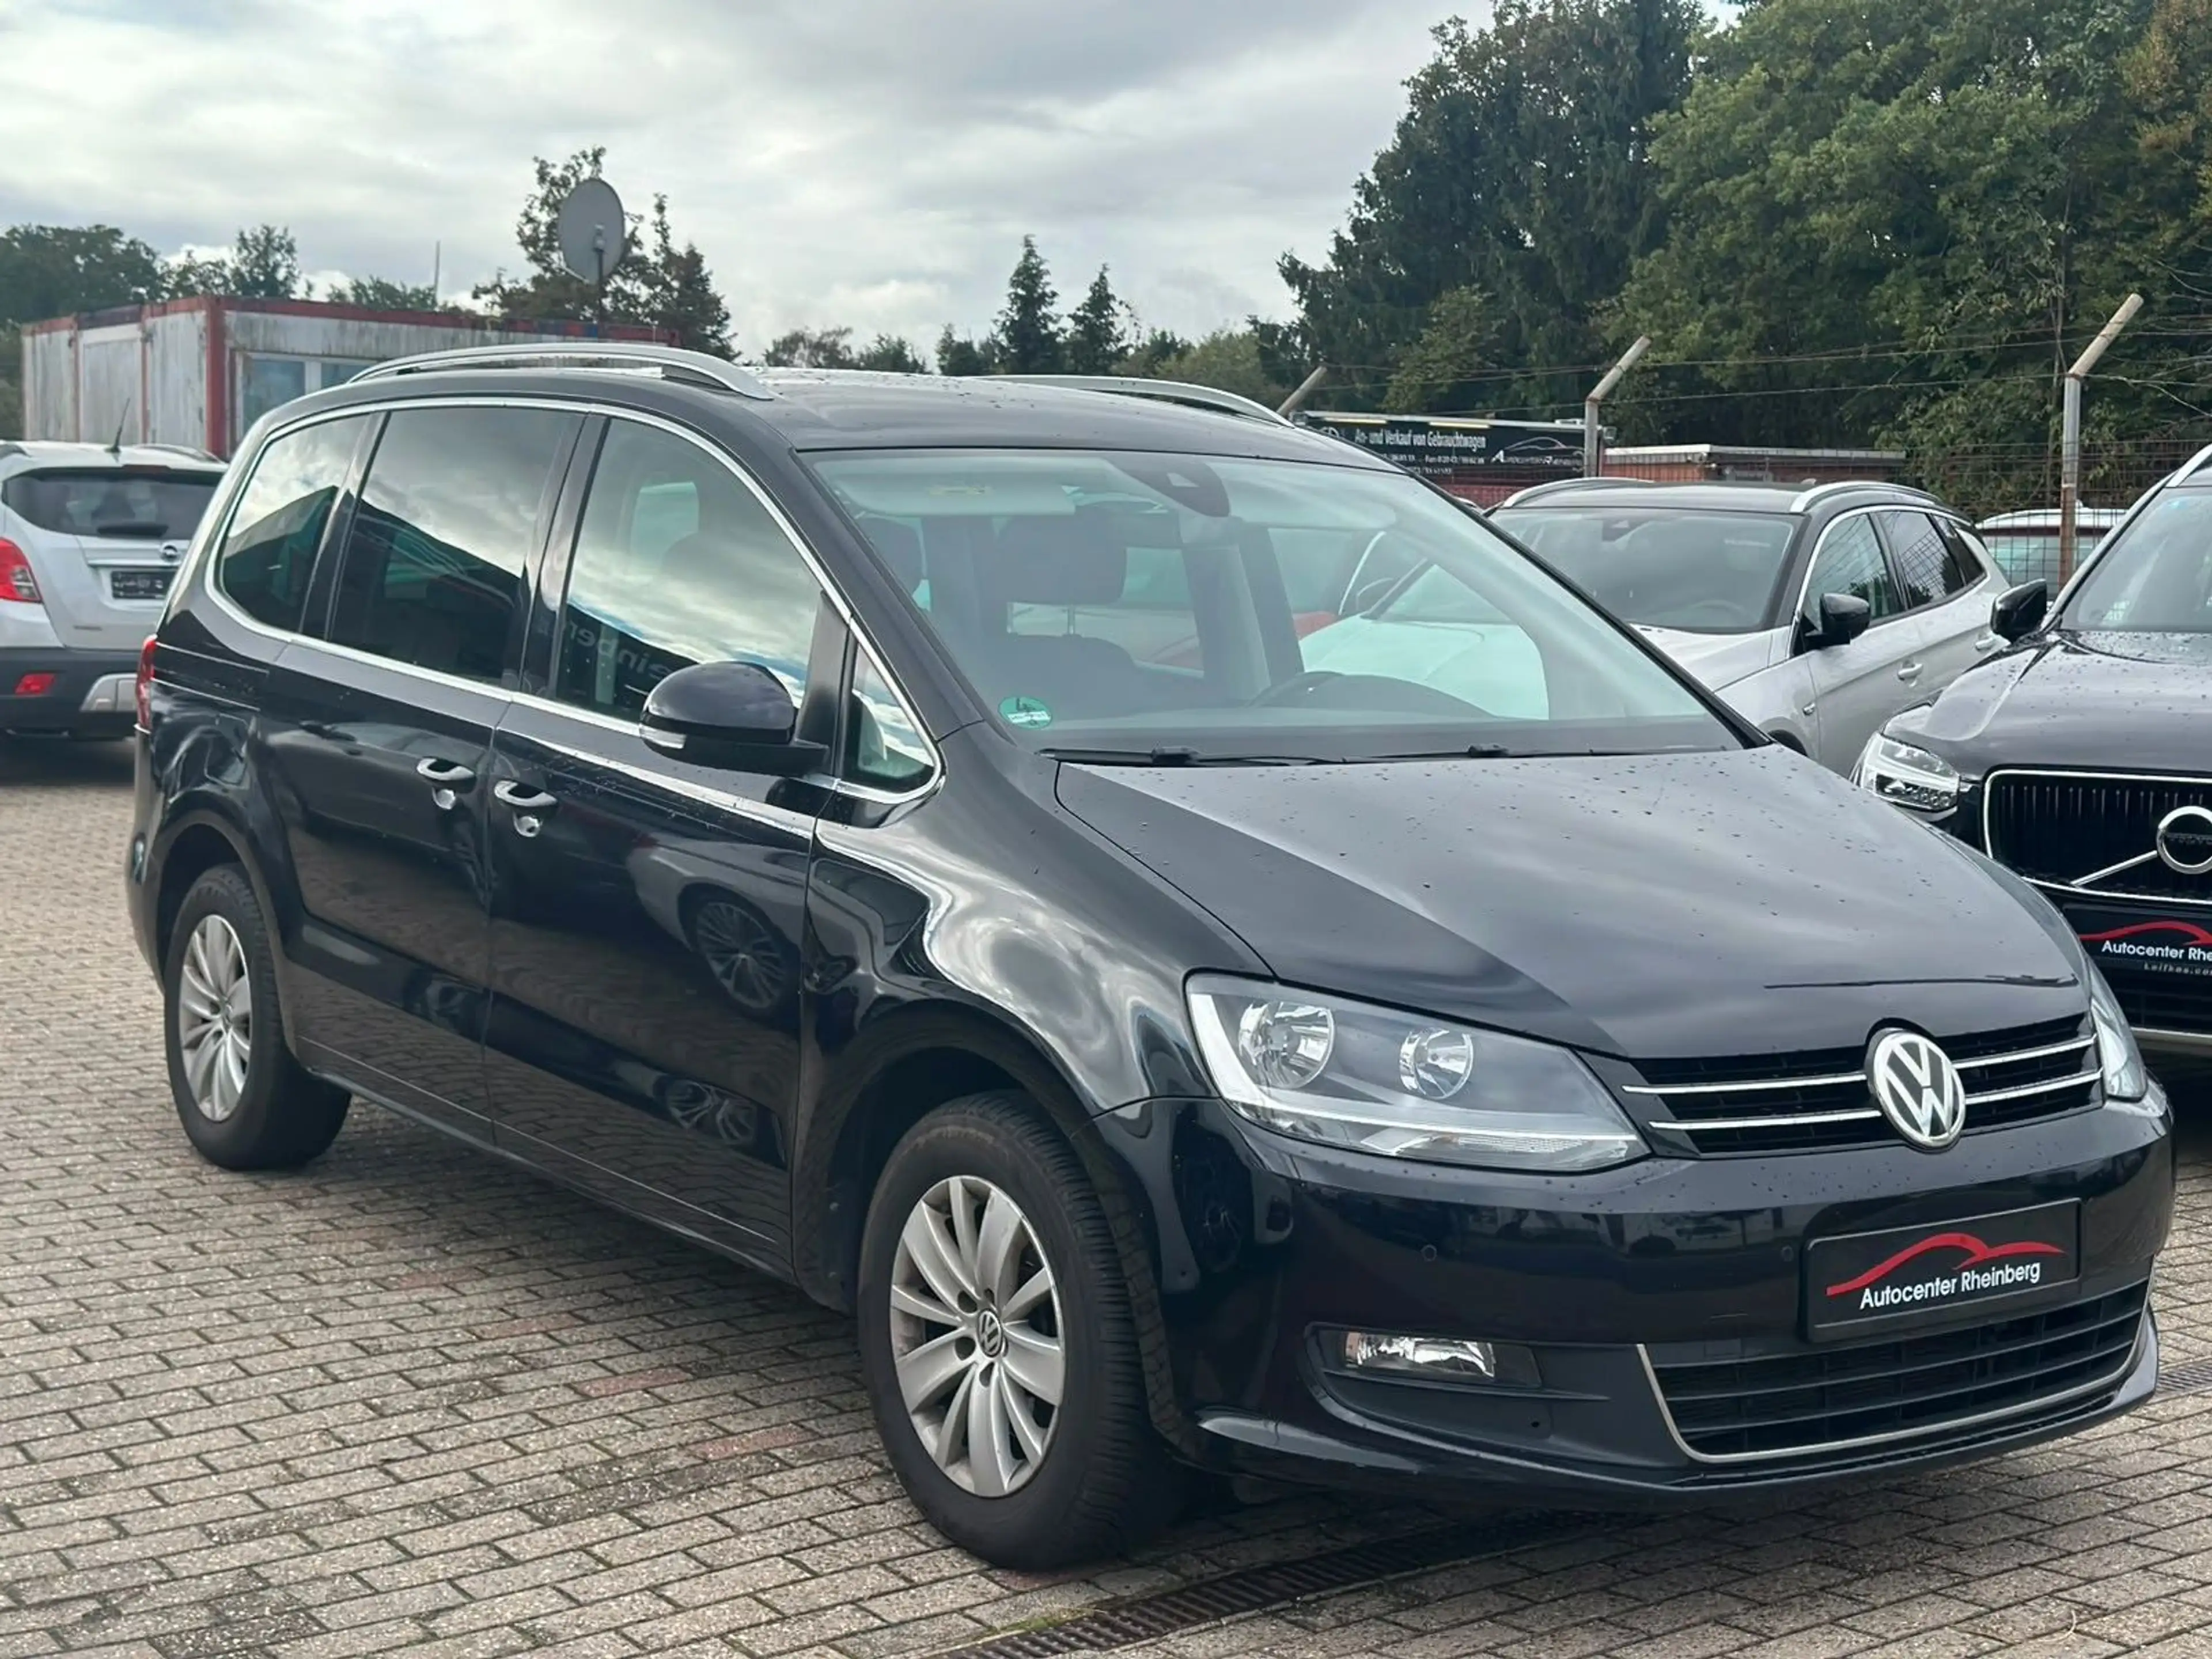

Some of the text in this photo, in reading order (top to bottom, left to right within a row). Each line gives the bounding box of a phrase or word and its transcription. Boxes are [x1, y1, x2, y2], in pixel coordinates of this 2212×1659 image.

[1369, 429, 1383, 445] und
[1384, 429, 1412, 445] Verkauf
[1413, 434, 1426, 446] von
[1427, 431, 1486, 452] Gebrauchtwagen
[2101, 940, 2185, 959] Autocenter
[1860, 1262, 2041, 1309] Autocenter Rheinberg
